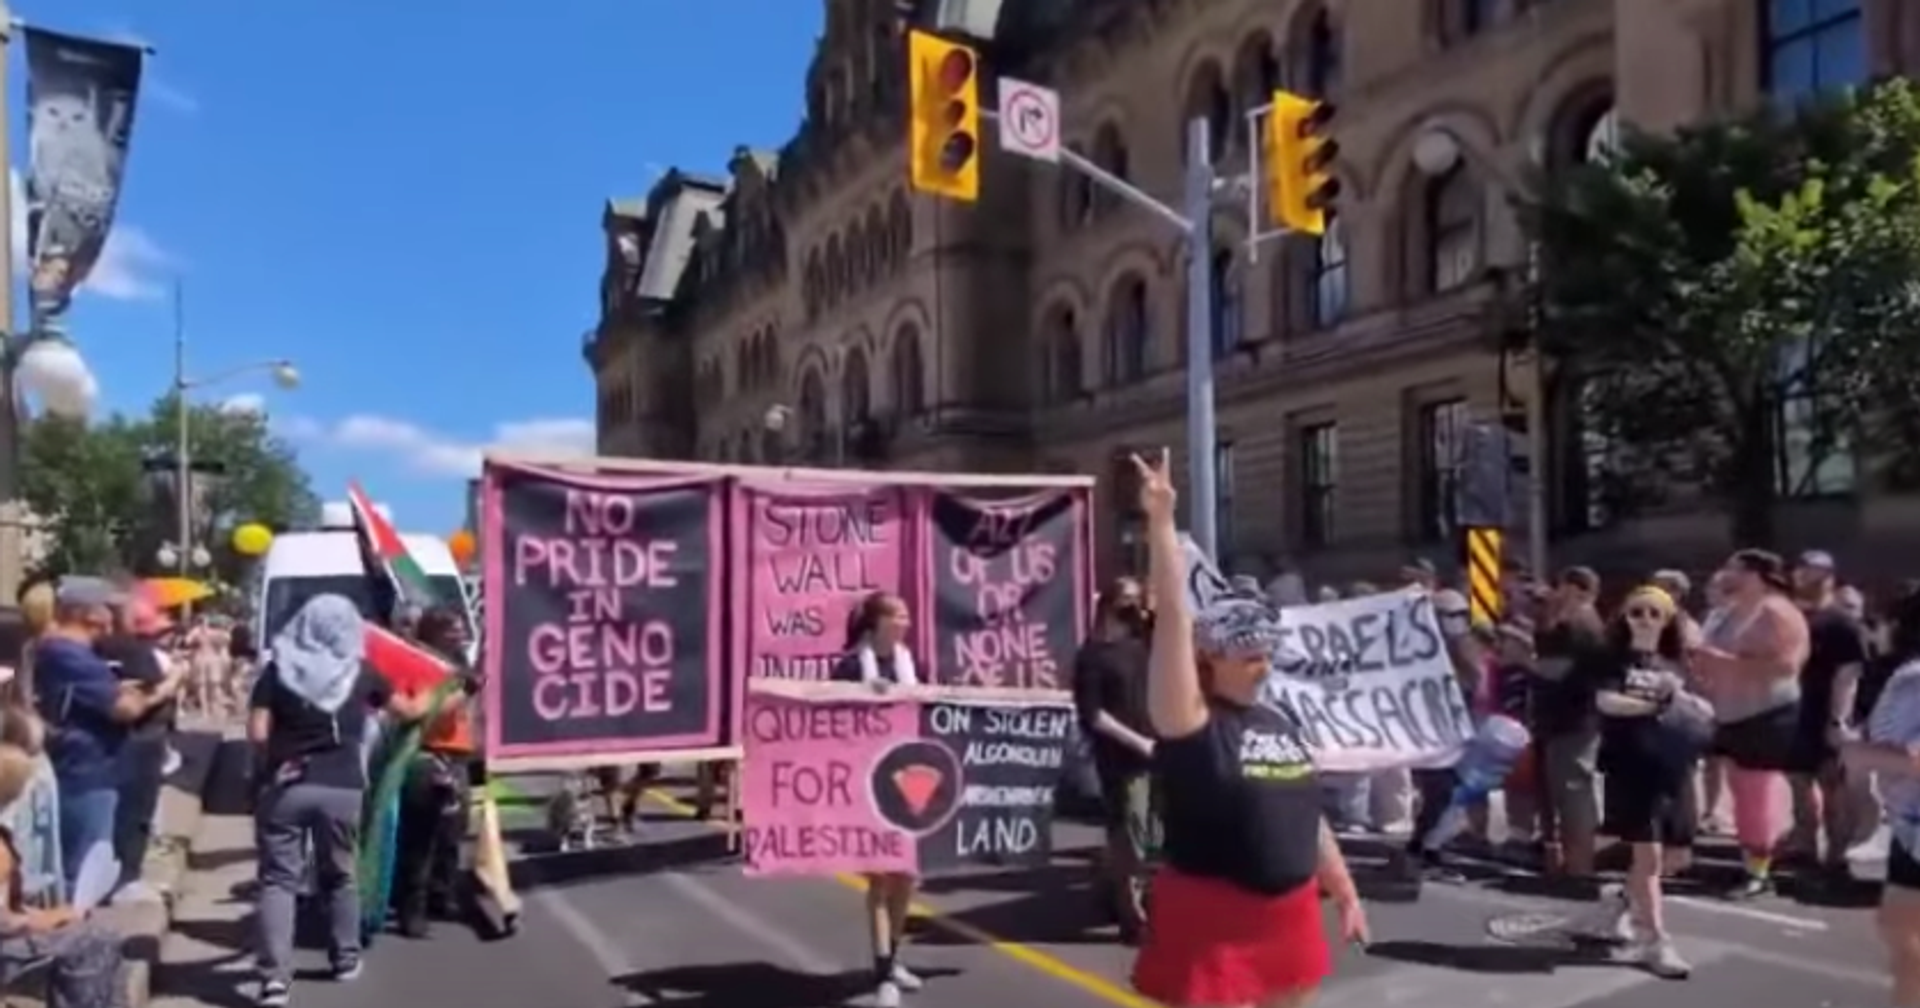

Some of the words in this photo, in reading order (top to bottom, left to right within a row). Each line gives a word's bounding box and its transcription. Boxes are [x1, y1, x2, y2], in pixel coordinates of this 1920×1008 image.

[566, 489, 633, 535] NO
[765, 500, 887, 546] STONE
[515, 535, 677, 587] PRIDE
[769, 553, 881, 594] WALL
[1012, 541, 1056, 585] US
[567, 589, 622, 622] IN
[765, 605, 826, 638] WAS
[528, 622, 673, 672] GENO
[954, 622, 1049, 668] NONE
[532, 670, 673, 720] CIDE
[751, 704, 893, 743] QUEERS
[930, 705, 971, 735] ON
[983, 709, 1068, 738] STOLEN
[771, 761, 852, 807] FOR
[744, 824, 904, 869] PALESTINE
[956, 817, 1037, 856] LAND
